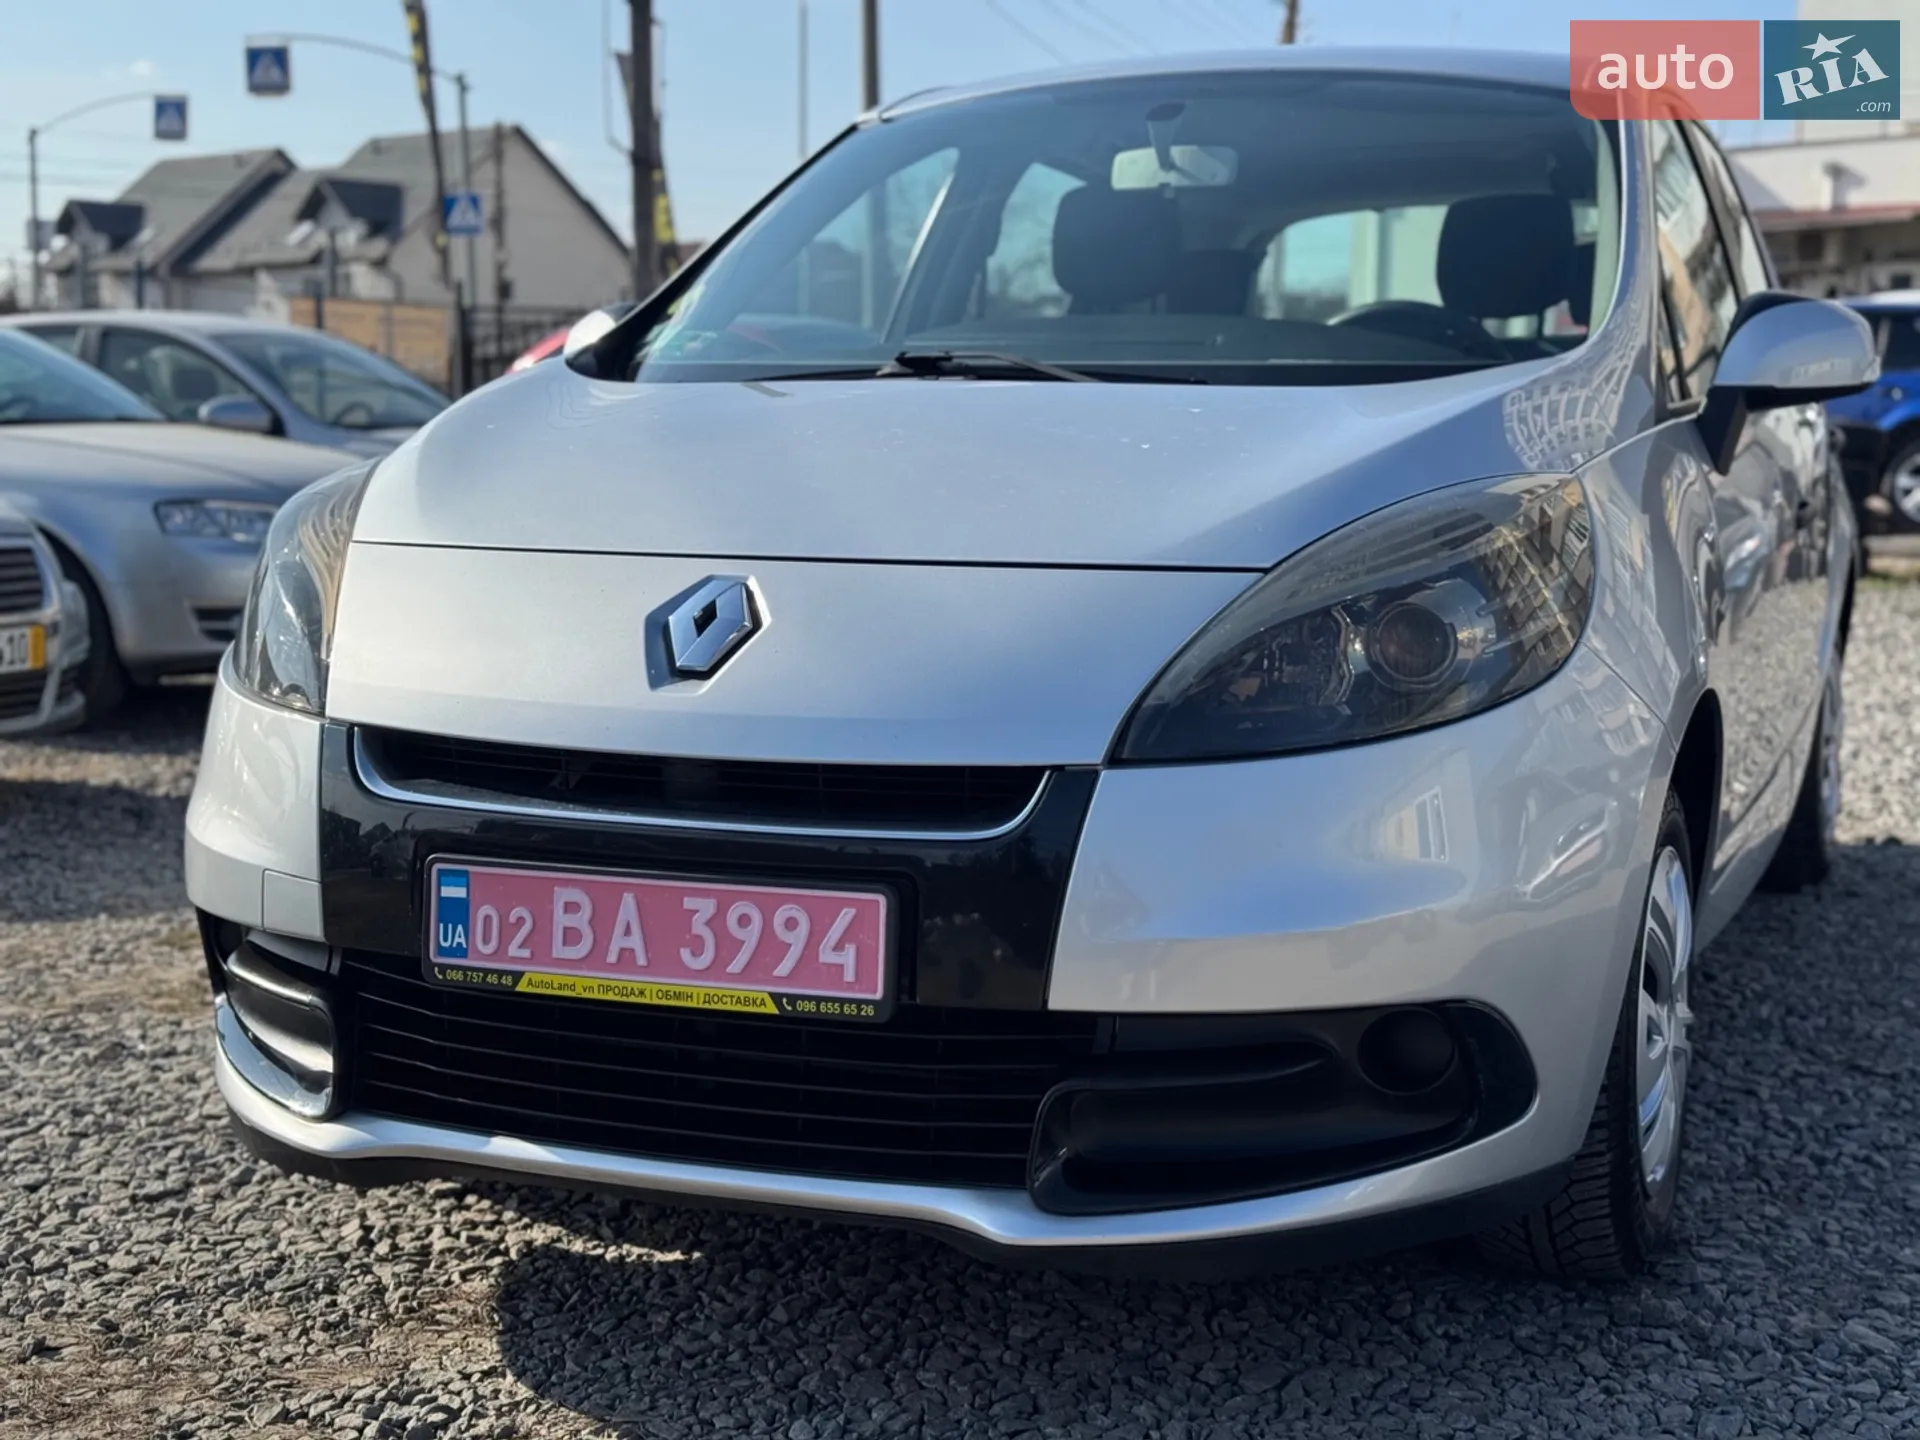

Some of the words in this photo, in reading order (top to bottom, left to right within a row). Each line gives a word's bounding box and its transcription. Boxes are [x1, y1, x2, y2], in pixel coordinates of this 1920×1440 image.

[439, 922, 467, 948] UA
[475, 904, 534, 959] 02
[679, 897, 857, 982] 3994
[446, 969, 463, 980] 066
[466, 971, 483, 982] 757
[486, 974, 499, 985] 46
[500, 974, 513, 986] 48
[597, 984, 647, 999] ПРОДАЖ
[655, 989, 694, 1003] ОБМІН
[702, 993, 768, 1008] ДОСТАВКА
[796, 1000, 817, 1013] 096
[819, 1001, 841, 1014] 655
[843, 1003, 858, 1015] 65
[860, 1004, 875, 1016] 26
